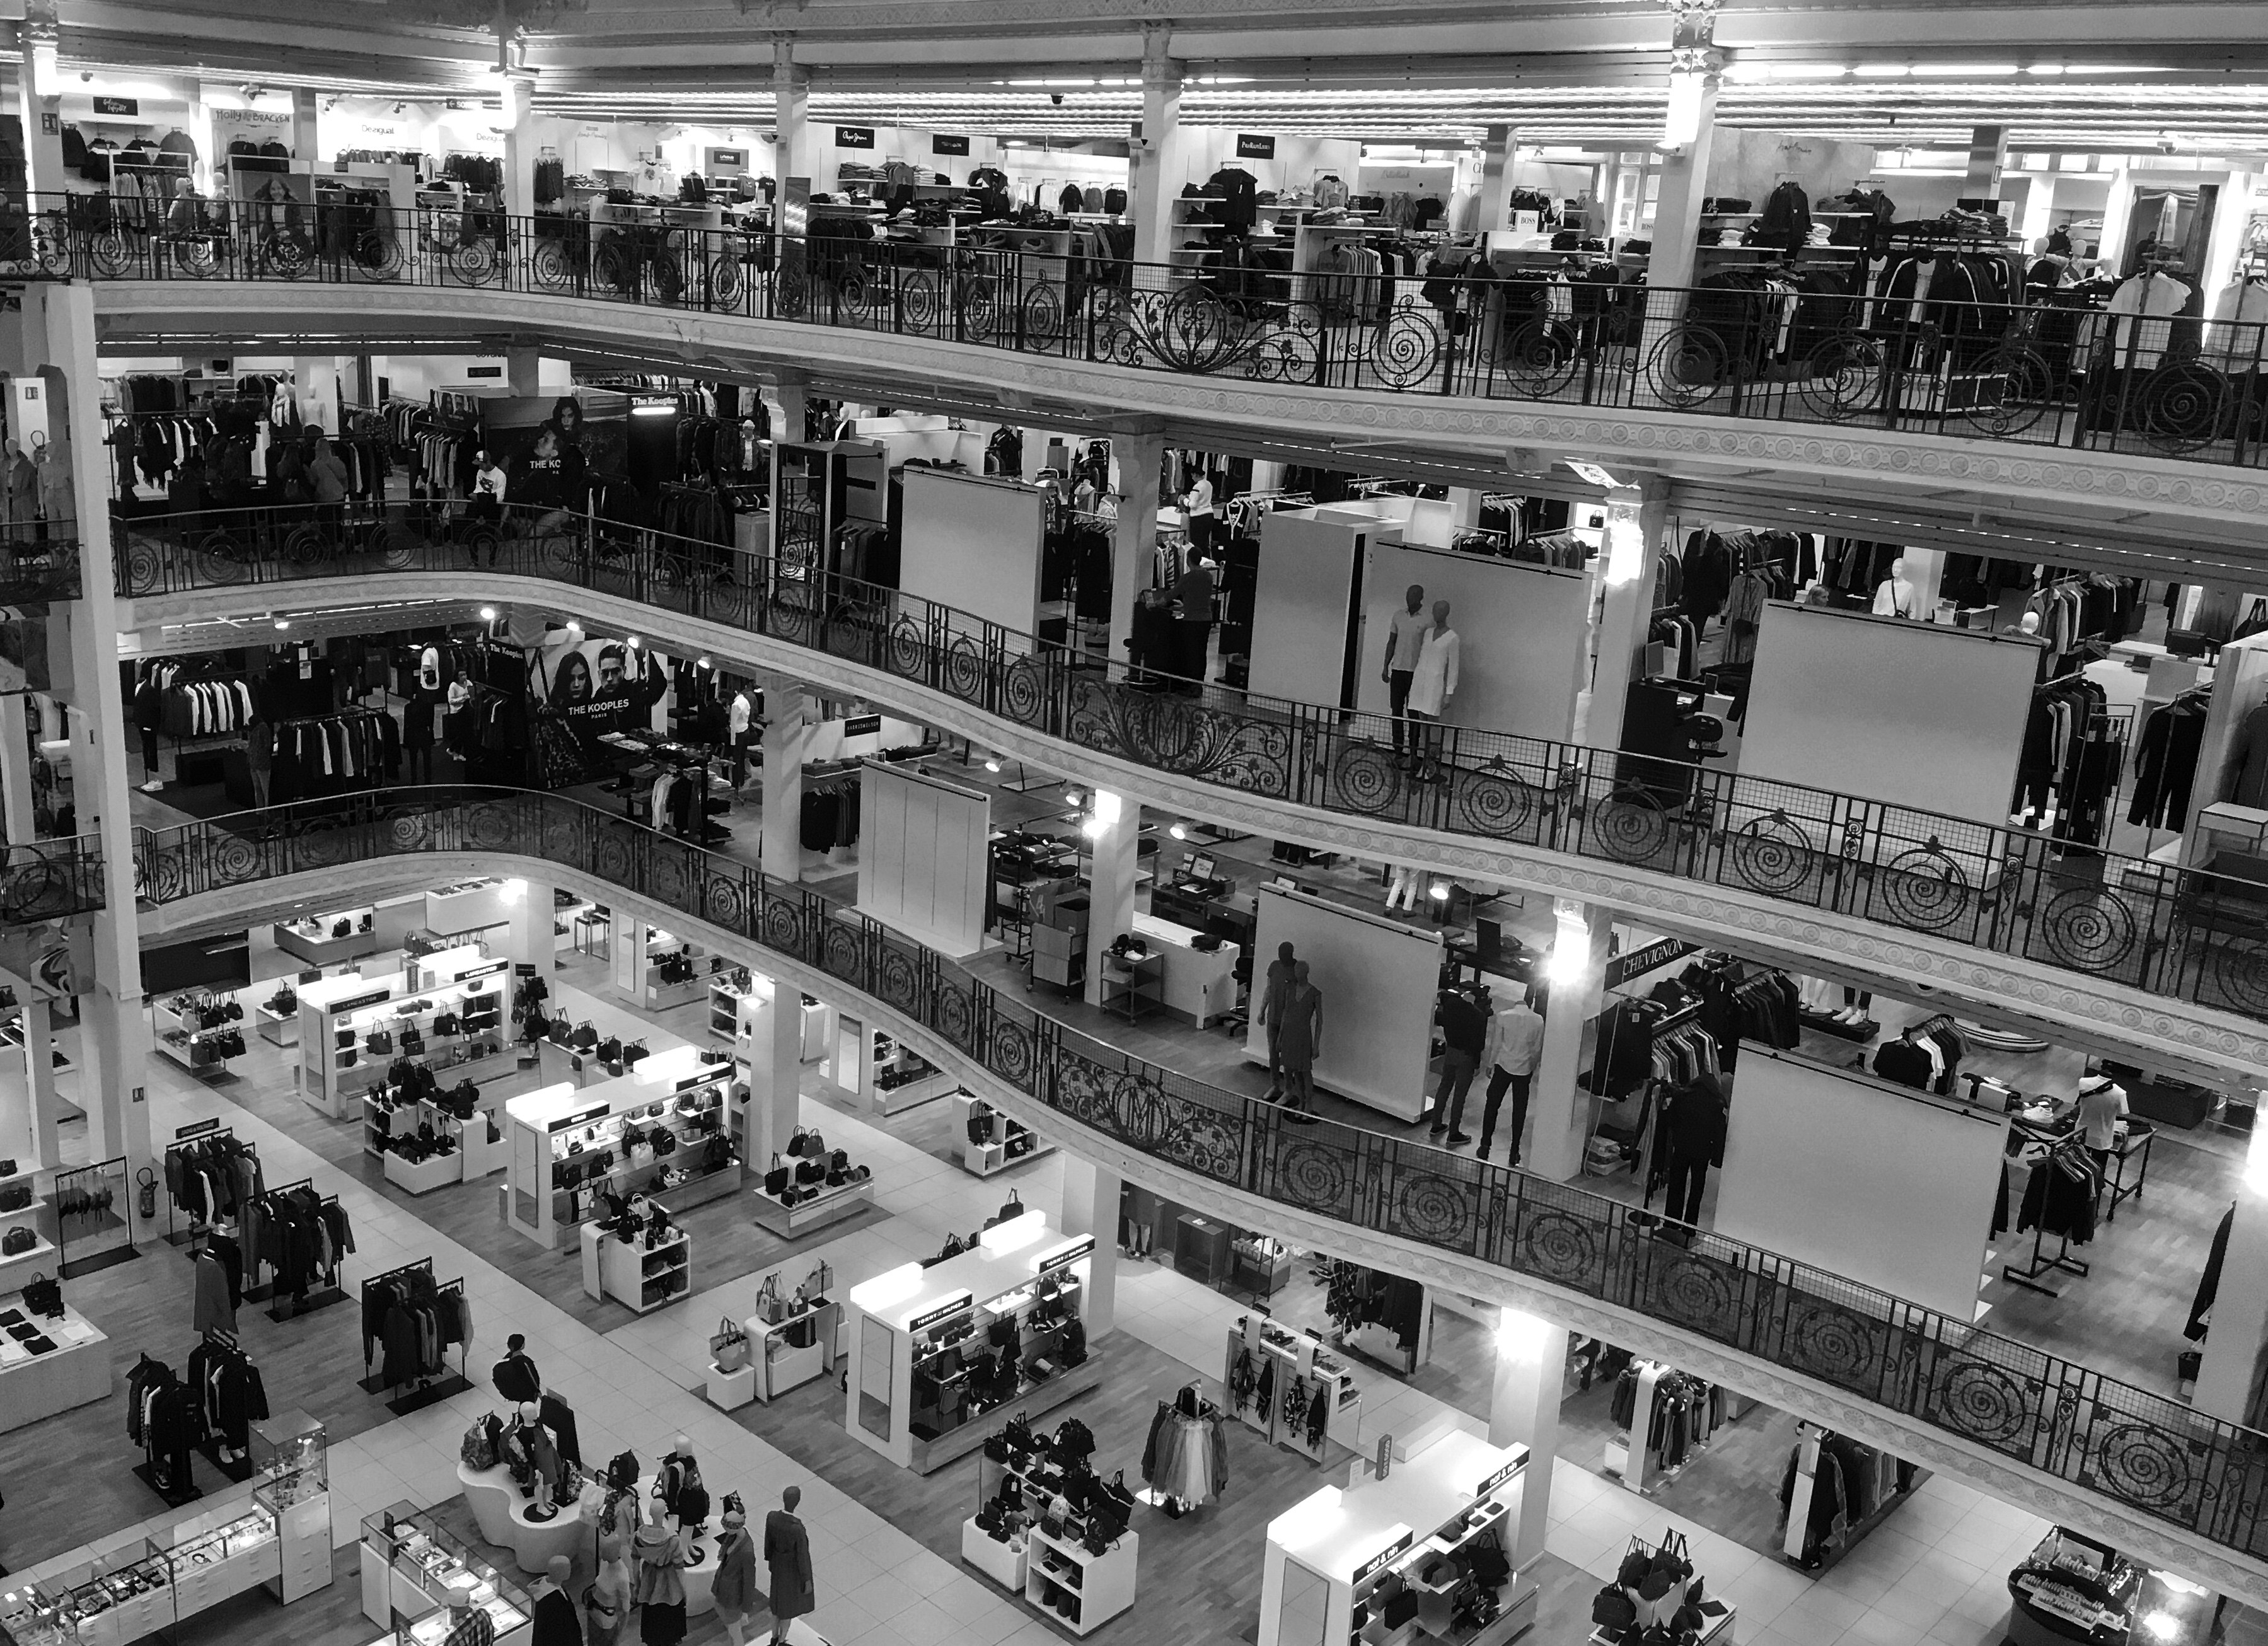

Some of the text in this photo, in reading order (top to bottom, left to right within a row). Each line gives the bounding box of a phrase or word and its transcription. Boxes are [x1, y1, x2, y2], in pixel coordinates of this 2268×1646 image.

[362, 125, 395, 135] Desigual
[1521, 216, 1536, 225] BOSS
[631, 396, 678, 406] The Kooples
[529, 460, 547, 468] THE
[568, 698, 629, 716] THE KOOPLES
[1623, 939, 1684, 976] CHEVIGNON
[917, 1301, 964, 1325] TOMMY HILFIGER
[1387, 1546, 1399, 1559] nin
